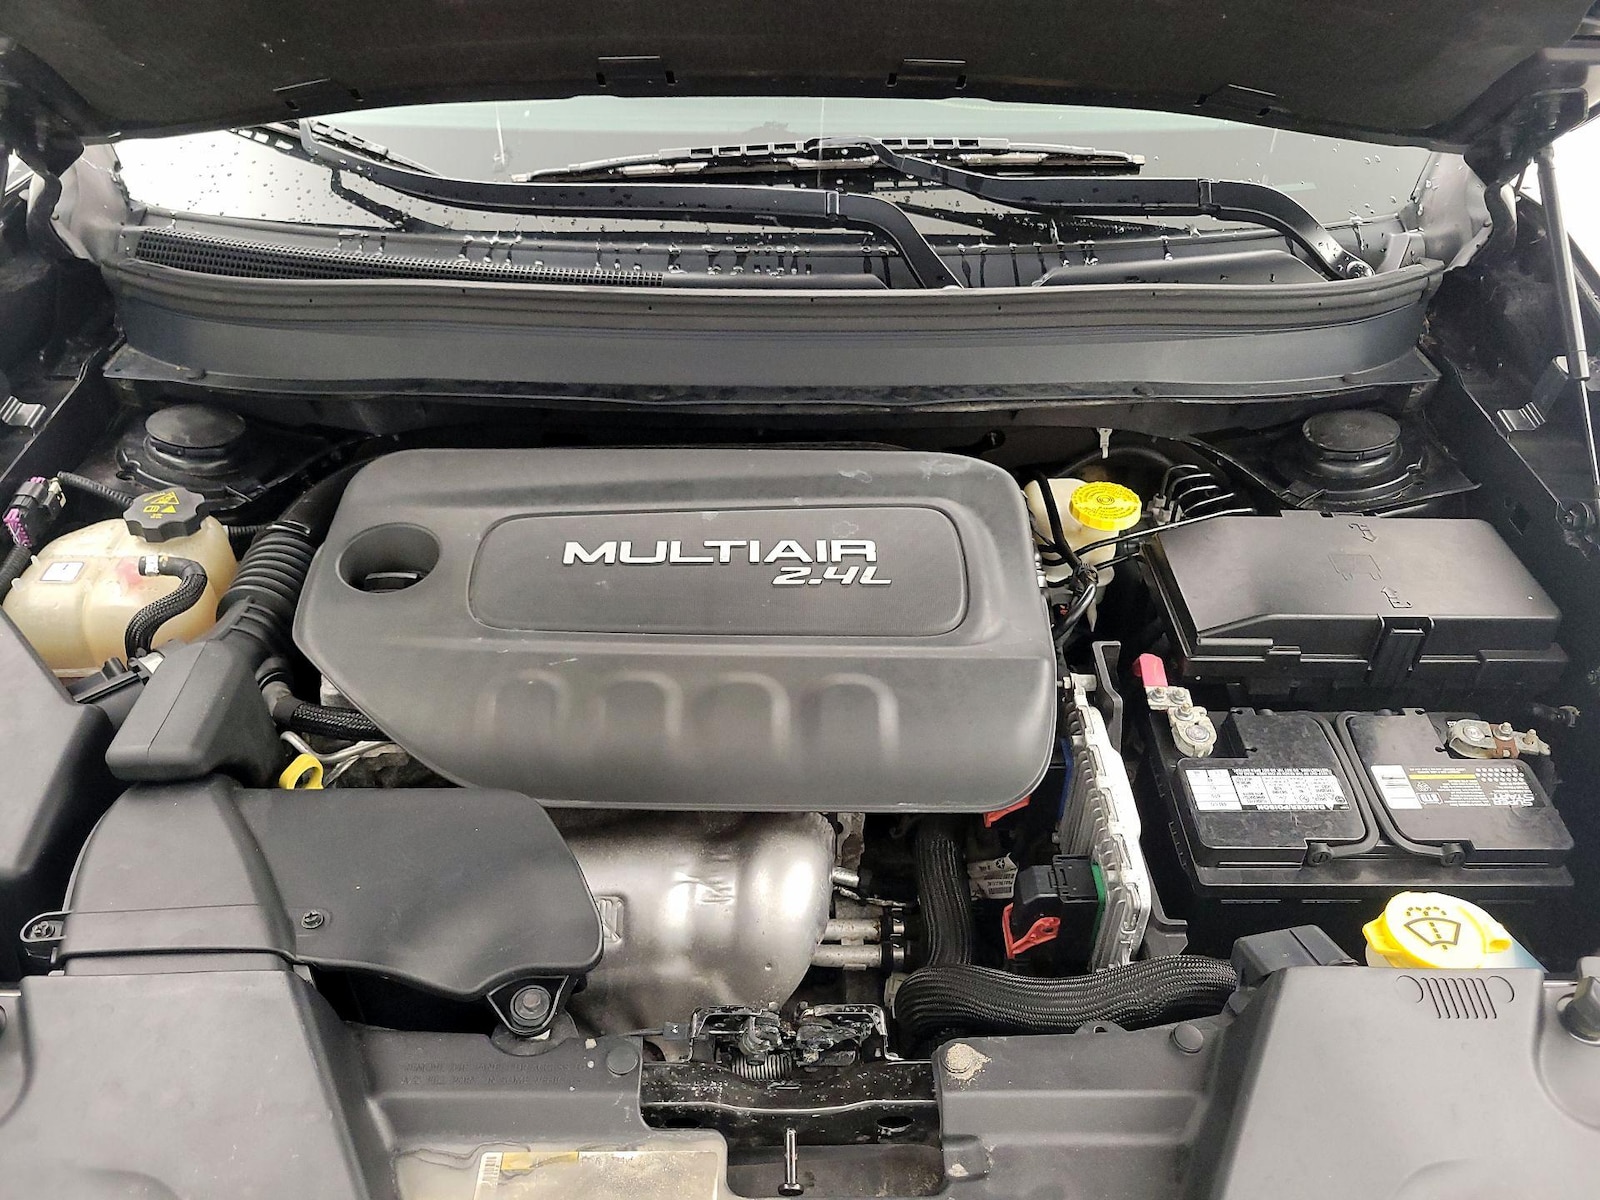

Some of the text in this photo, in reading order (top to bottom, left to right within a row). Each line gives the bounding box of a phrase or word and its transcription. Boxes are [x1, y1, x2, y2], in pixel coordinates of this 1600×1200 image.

[562, 539, 878, 565] MULTIAIR
[771, 565, 893, 586] 2.4L
[1491, 793, 1535, 801] START
